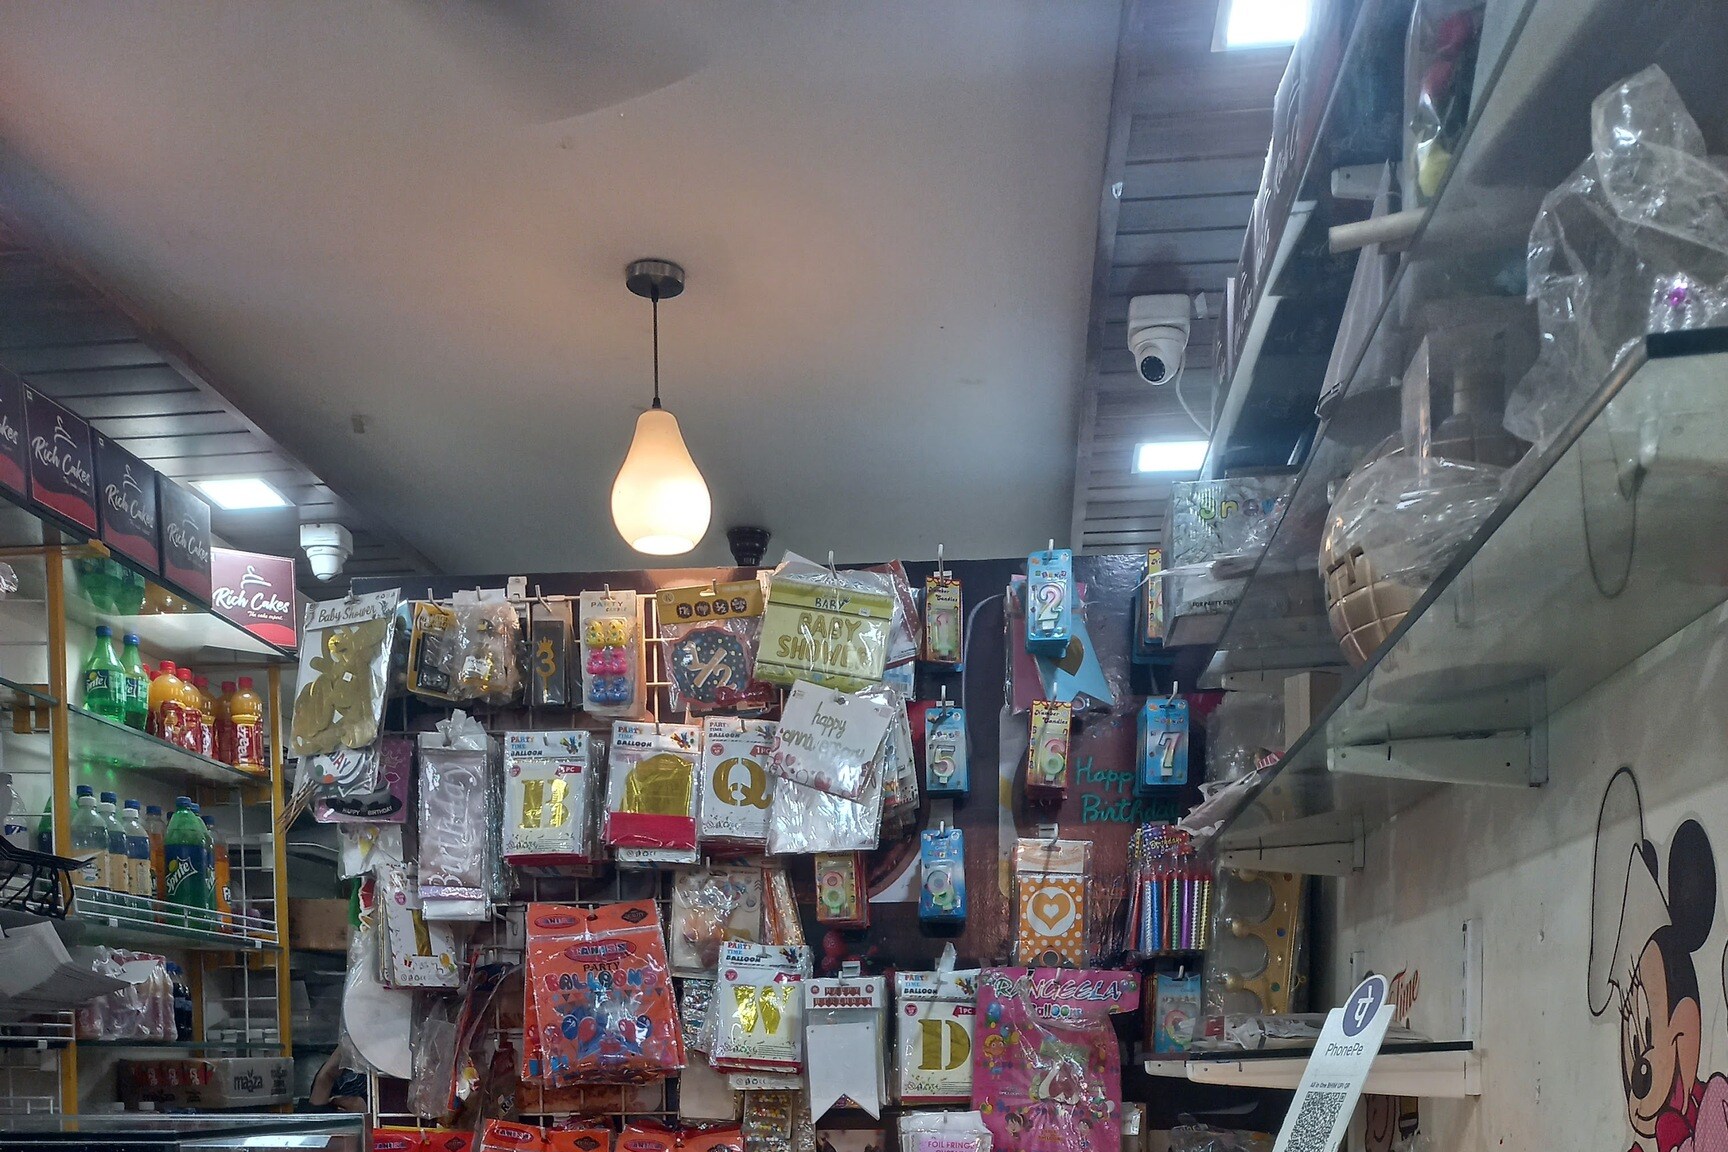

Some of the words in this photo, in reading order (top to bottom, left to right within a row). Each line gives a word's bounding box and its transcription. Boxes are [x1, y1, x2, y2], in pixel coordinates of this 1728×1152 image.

[31, 436, 60, 468] Rich
[62, 454, 91, 487] Cakes
[105, 484, 129, 512] Rich
[130, 500, 154, 529] Cakes
[167, 522, 187, 548] Rich
[187, 536, 209, 563] Cakes
[212, 587, 248, 610] Rich
[250, 593, 290, 614] Cakes
[318, 605, 342, 622] Baby
[342, 604, 377, 620] Shower
[815, 596, 846, 610] BABY
[797, 611, 862, 642] BABY
[617, 725, 643, 733] PARTY
[811, 701, 847, 738] happy
[1043, 716, 1069, 725] Candles
[616, 739, 653, 748] BALLOON
[712, 757, 773, 810] Q
[1075, 756, 1134, 793] Happ
[342, 808, 360, 816] HAPPY
[367, 805, 394, 816] BIRTHDAY
[166, 861, 191, 893] Sprite
[583, 961, 621, 972] PARTY
[725, 955, 761, 963] BALLOON
[544, 967, 658, 992] BALLOONS
[993, 974, 1122, 1001] RANGEELA
[917, 1019, 971, 1071] D
[1325, 1042, 1364, 1058] PhonePe
[928, 1140, 945, 1149] FOIL
